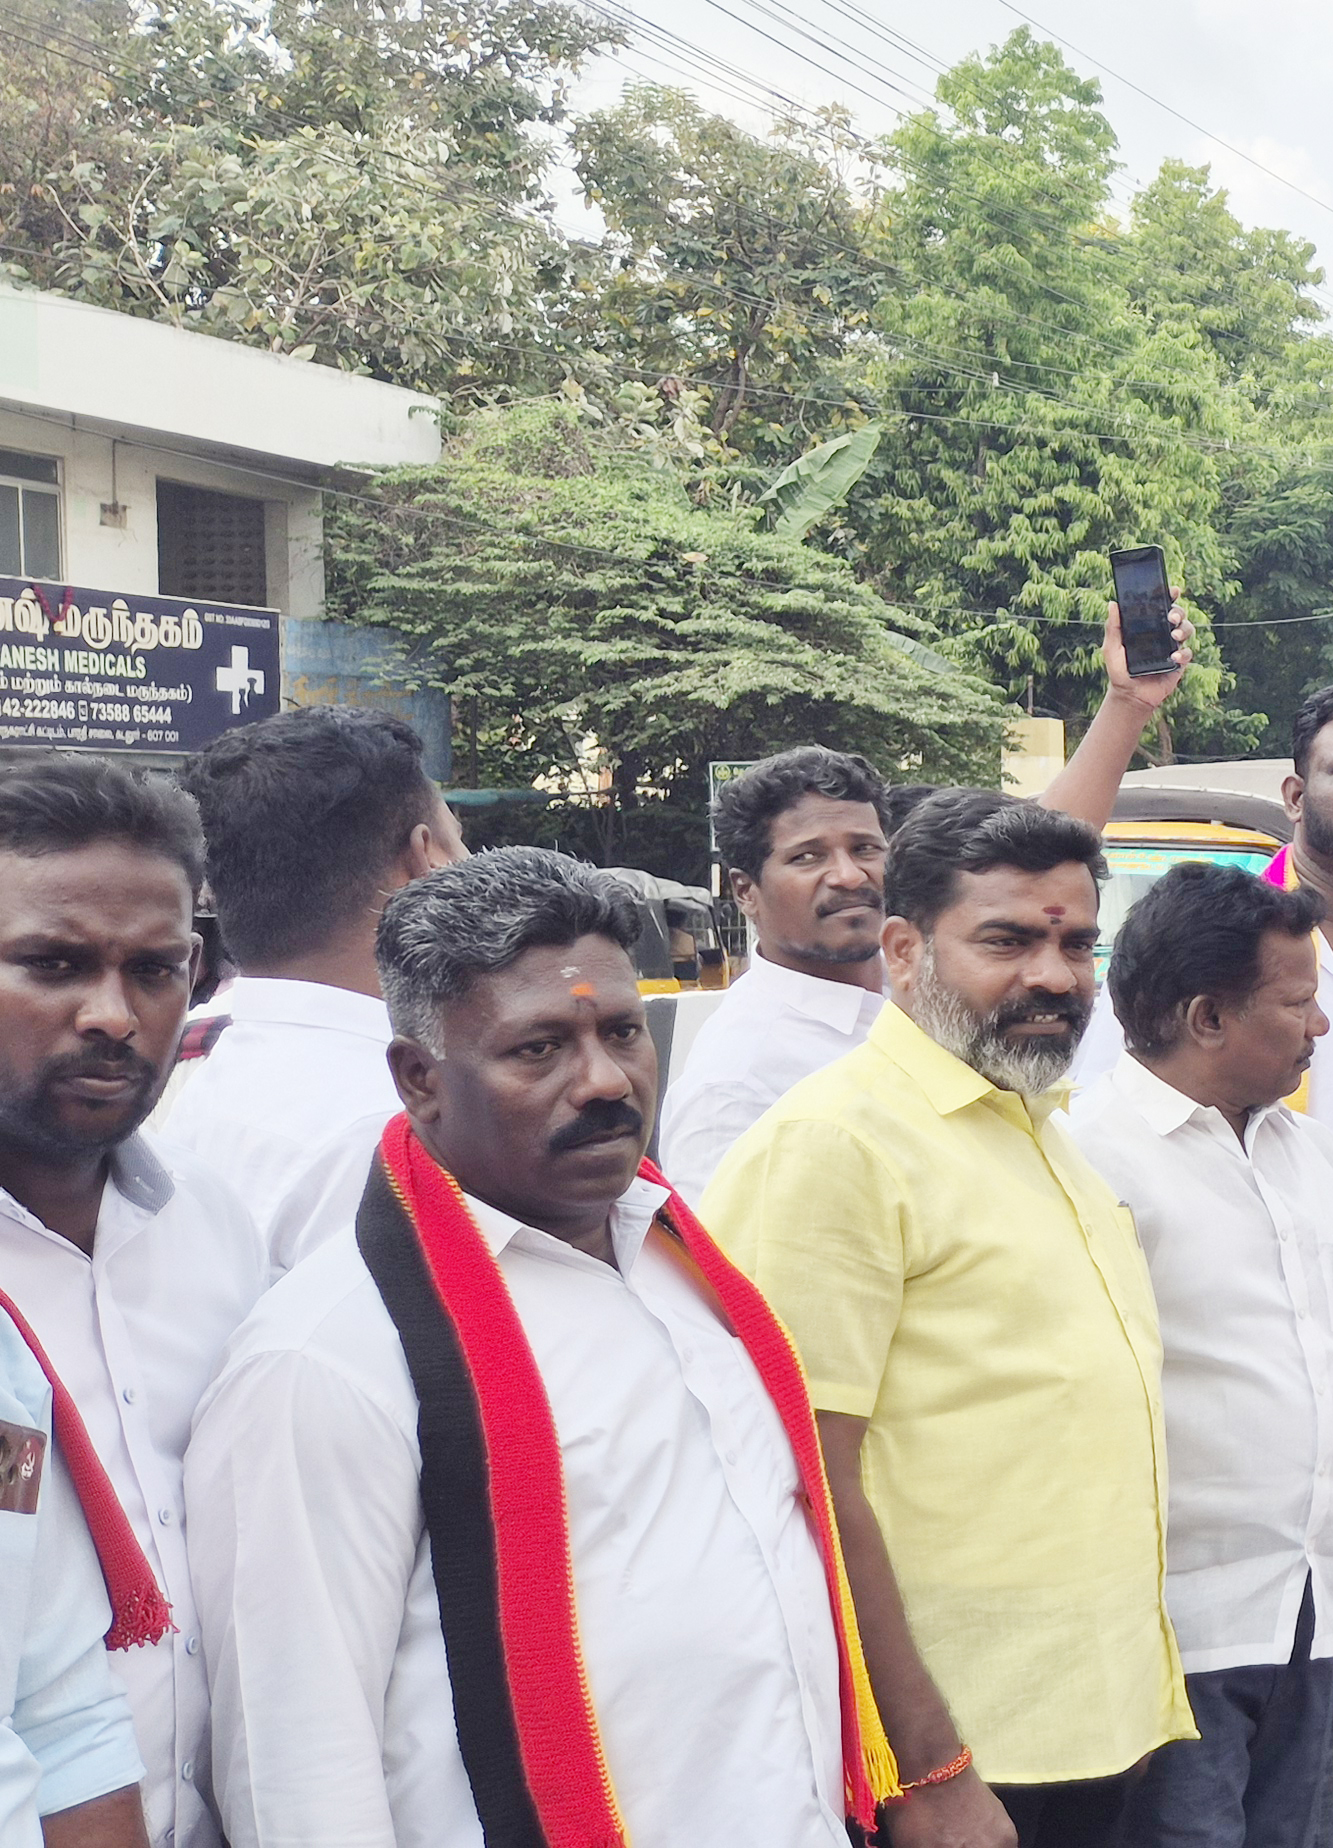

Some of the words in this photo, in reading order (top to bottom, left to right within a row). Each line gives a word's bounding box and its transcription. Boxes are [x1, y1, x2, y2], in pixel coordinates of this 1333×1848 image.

[0, 643, 60, 672] ANESH
[64, 649, 147, 679] MEDICALS
[11, 671, 62, 697] மற்றும்
[0, 697, 76, 719] 42-222846
[90, 702, 130, 723] 73588
[133, 705, 172, 724] 65444
